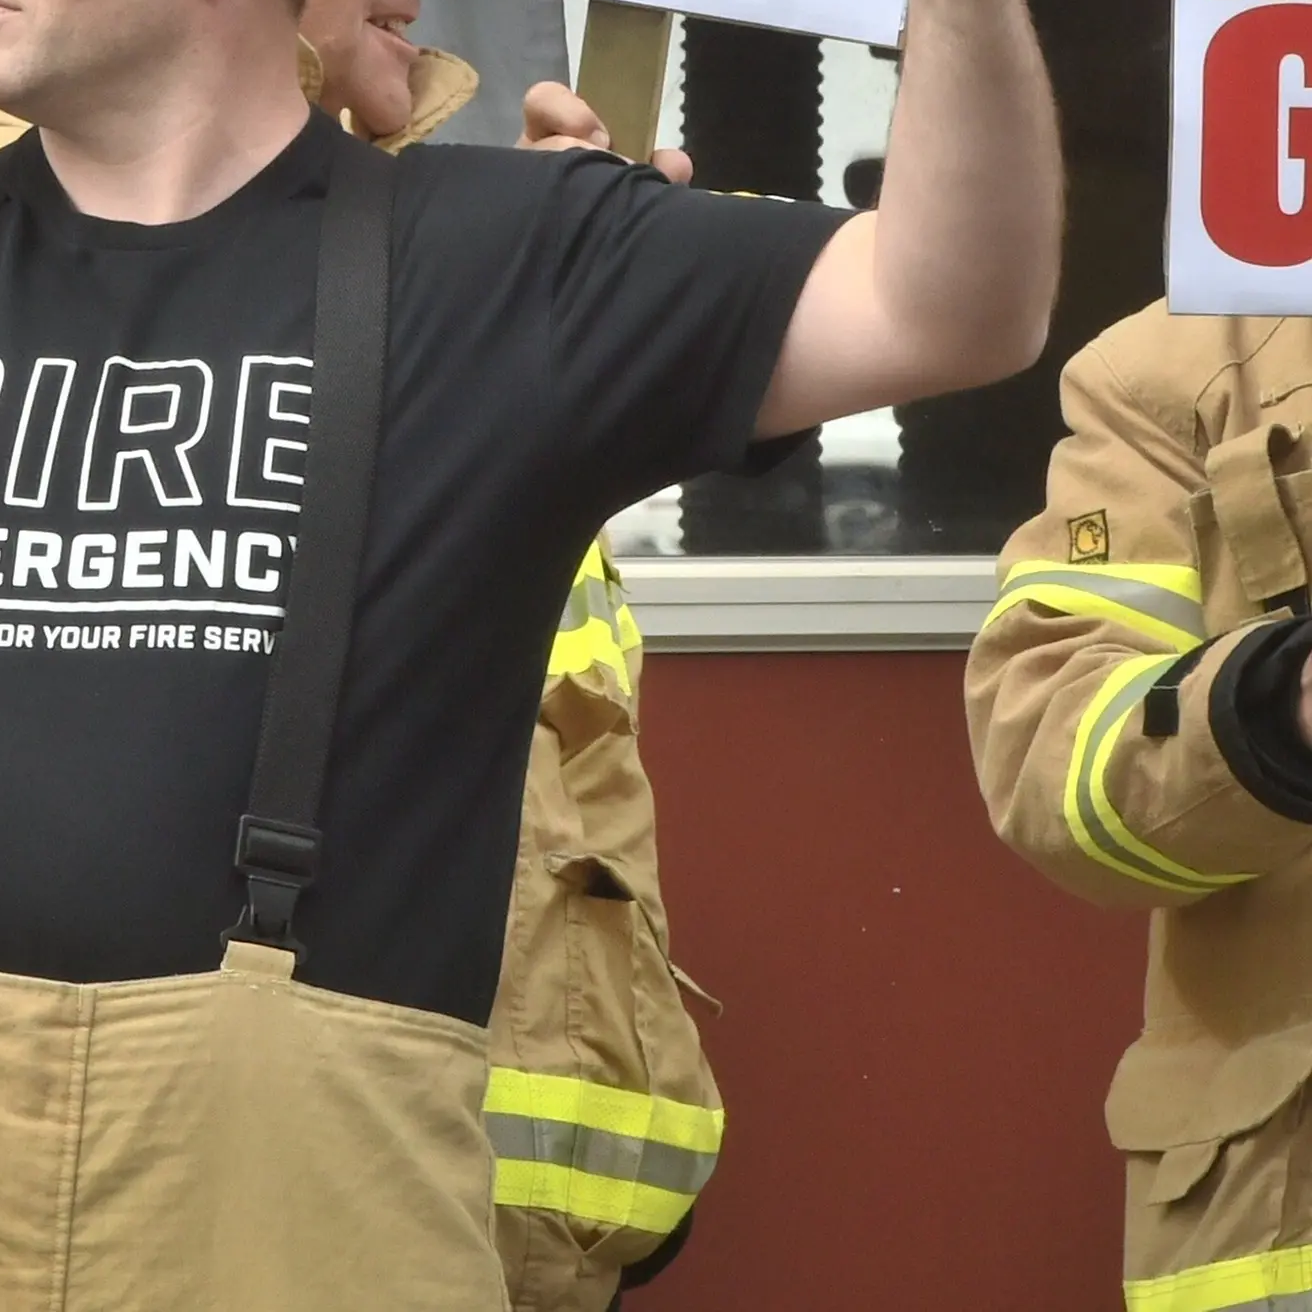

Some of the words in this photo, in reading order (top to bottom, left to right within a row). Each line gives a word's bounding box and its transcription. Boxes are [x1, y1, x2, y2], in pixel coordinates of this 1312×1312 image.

[42, 624, 120, 650] YOUR
[129, 625, 195, 649] FIRE
[203, 626, 275, 655] SERV
